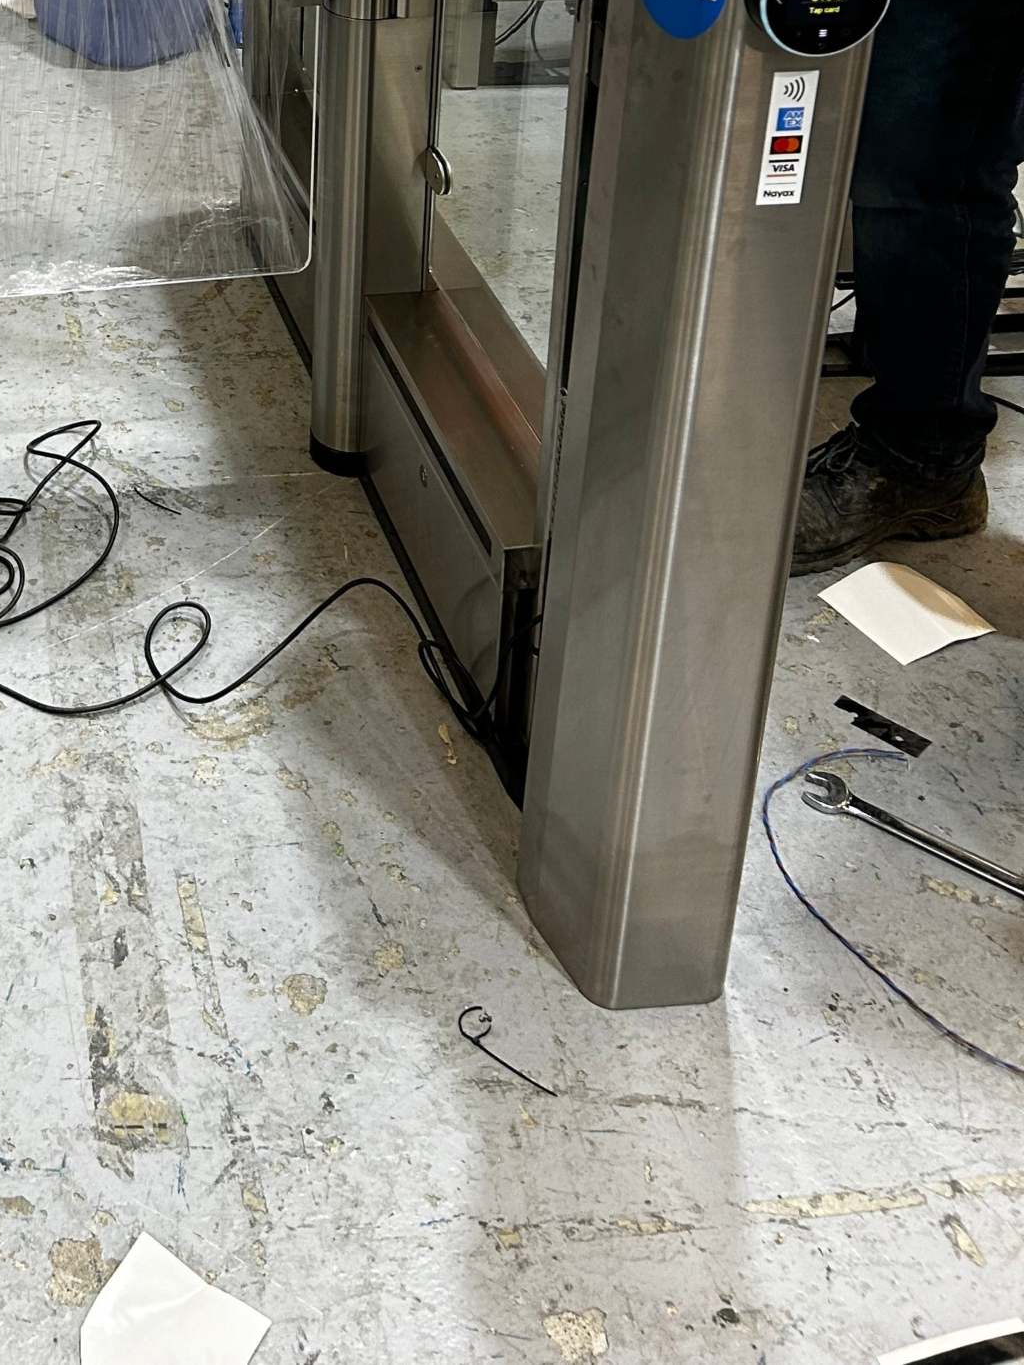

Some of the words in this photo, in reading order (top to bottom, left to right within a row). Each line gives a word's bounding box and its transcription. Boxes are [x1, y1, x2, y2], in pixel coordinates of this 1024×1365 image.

[809, 7, 823, 15] Tap
[824, 6, 841, 14] card
[772, 163, 795, 172] VISA
[763, 190, 795, 198] Nayax
